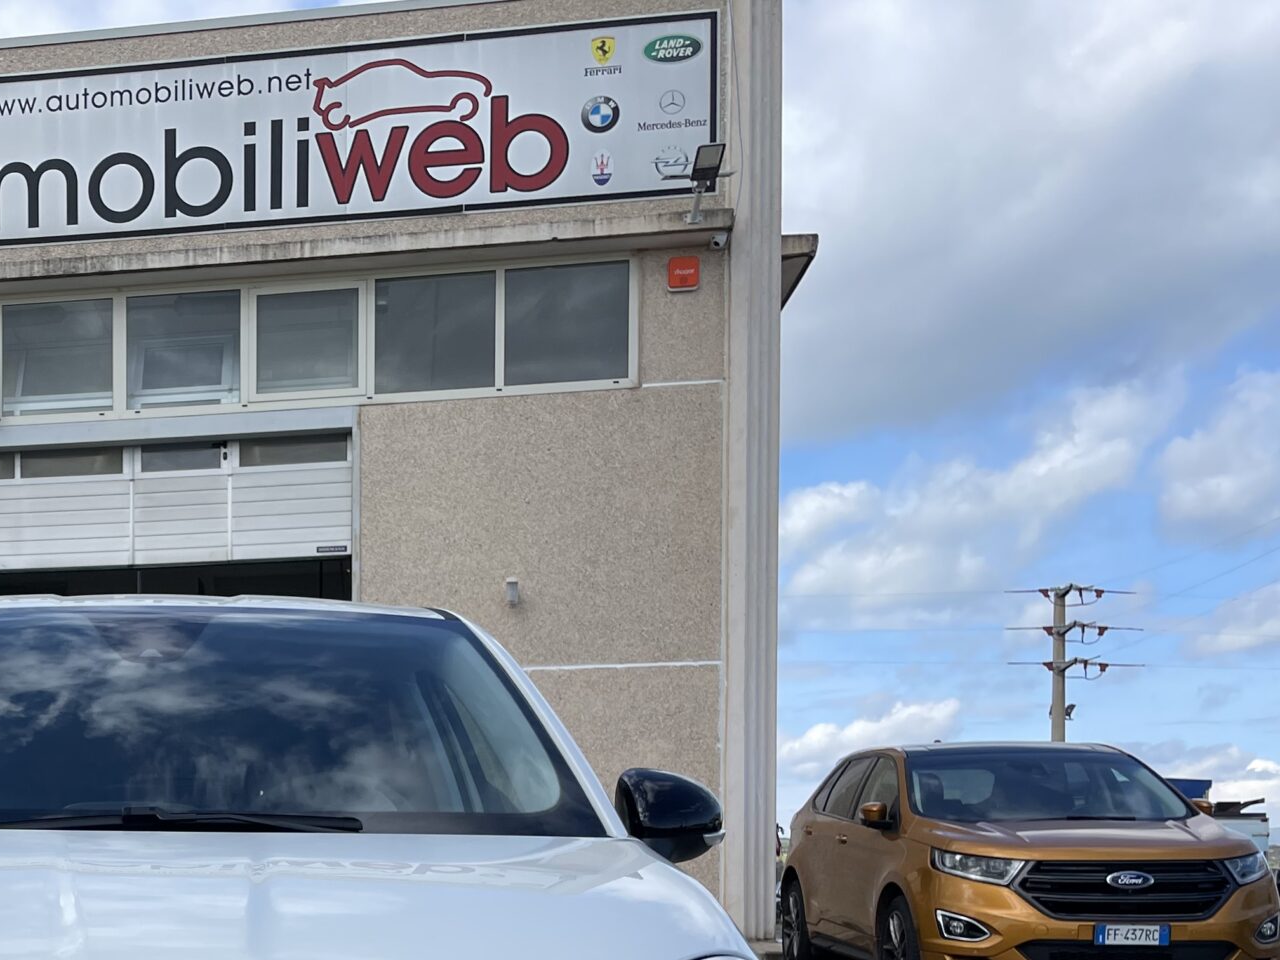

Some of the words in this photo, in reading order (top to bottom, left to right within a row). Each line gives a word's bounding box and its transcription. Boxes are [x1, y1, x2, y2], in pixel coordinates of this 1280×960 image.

[584, 65, 622, 77] Ferrari
[637, 118, 708, 132] Mercedes-Benz
[1118, 874, 1144, 884] Ford
